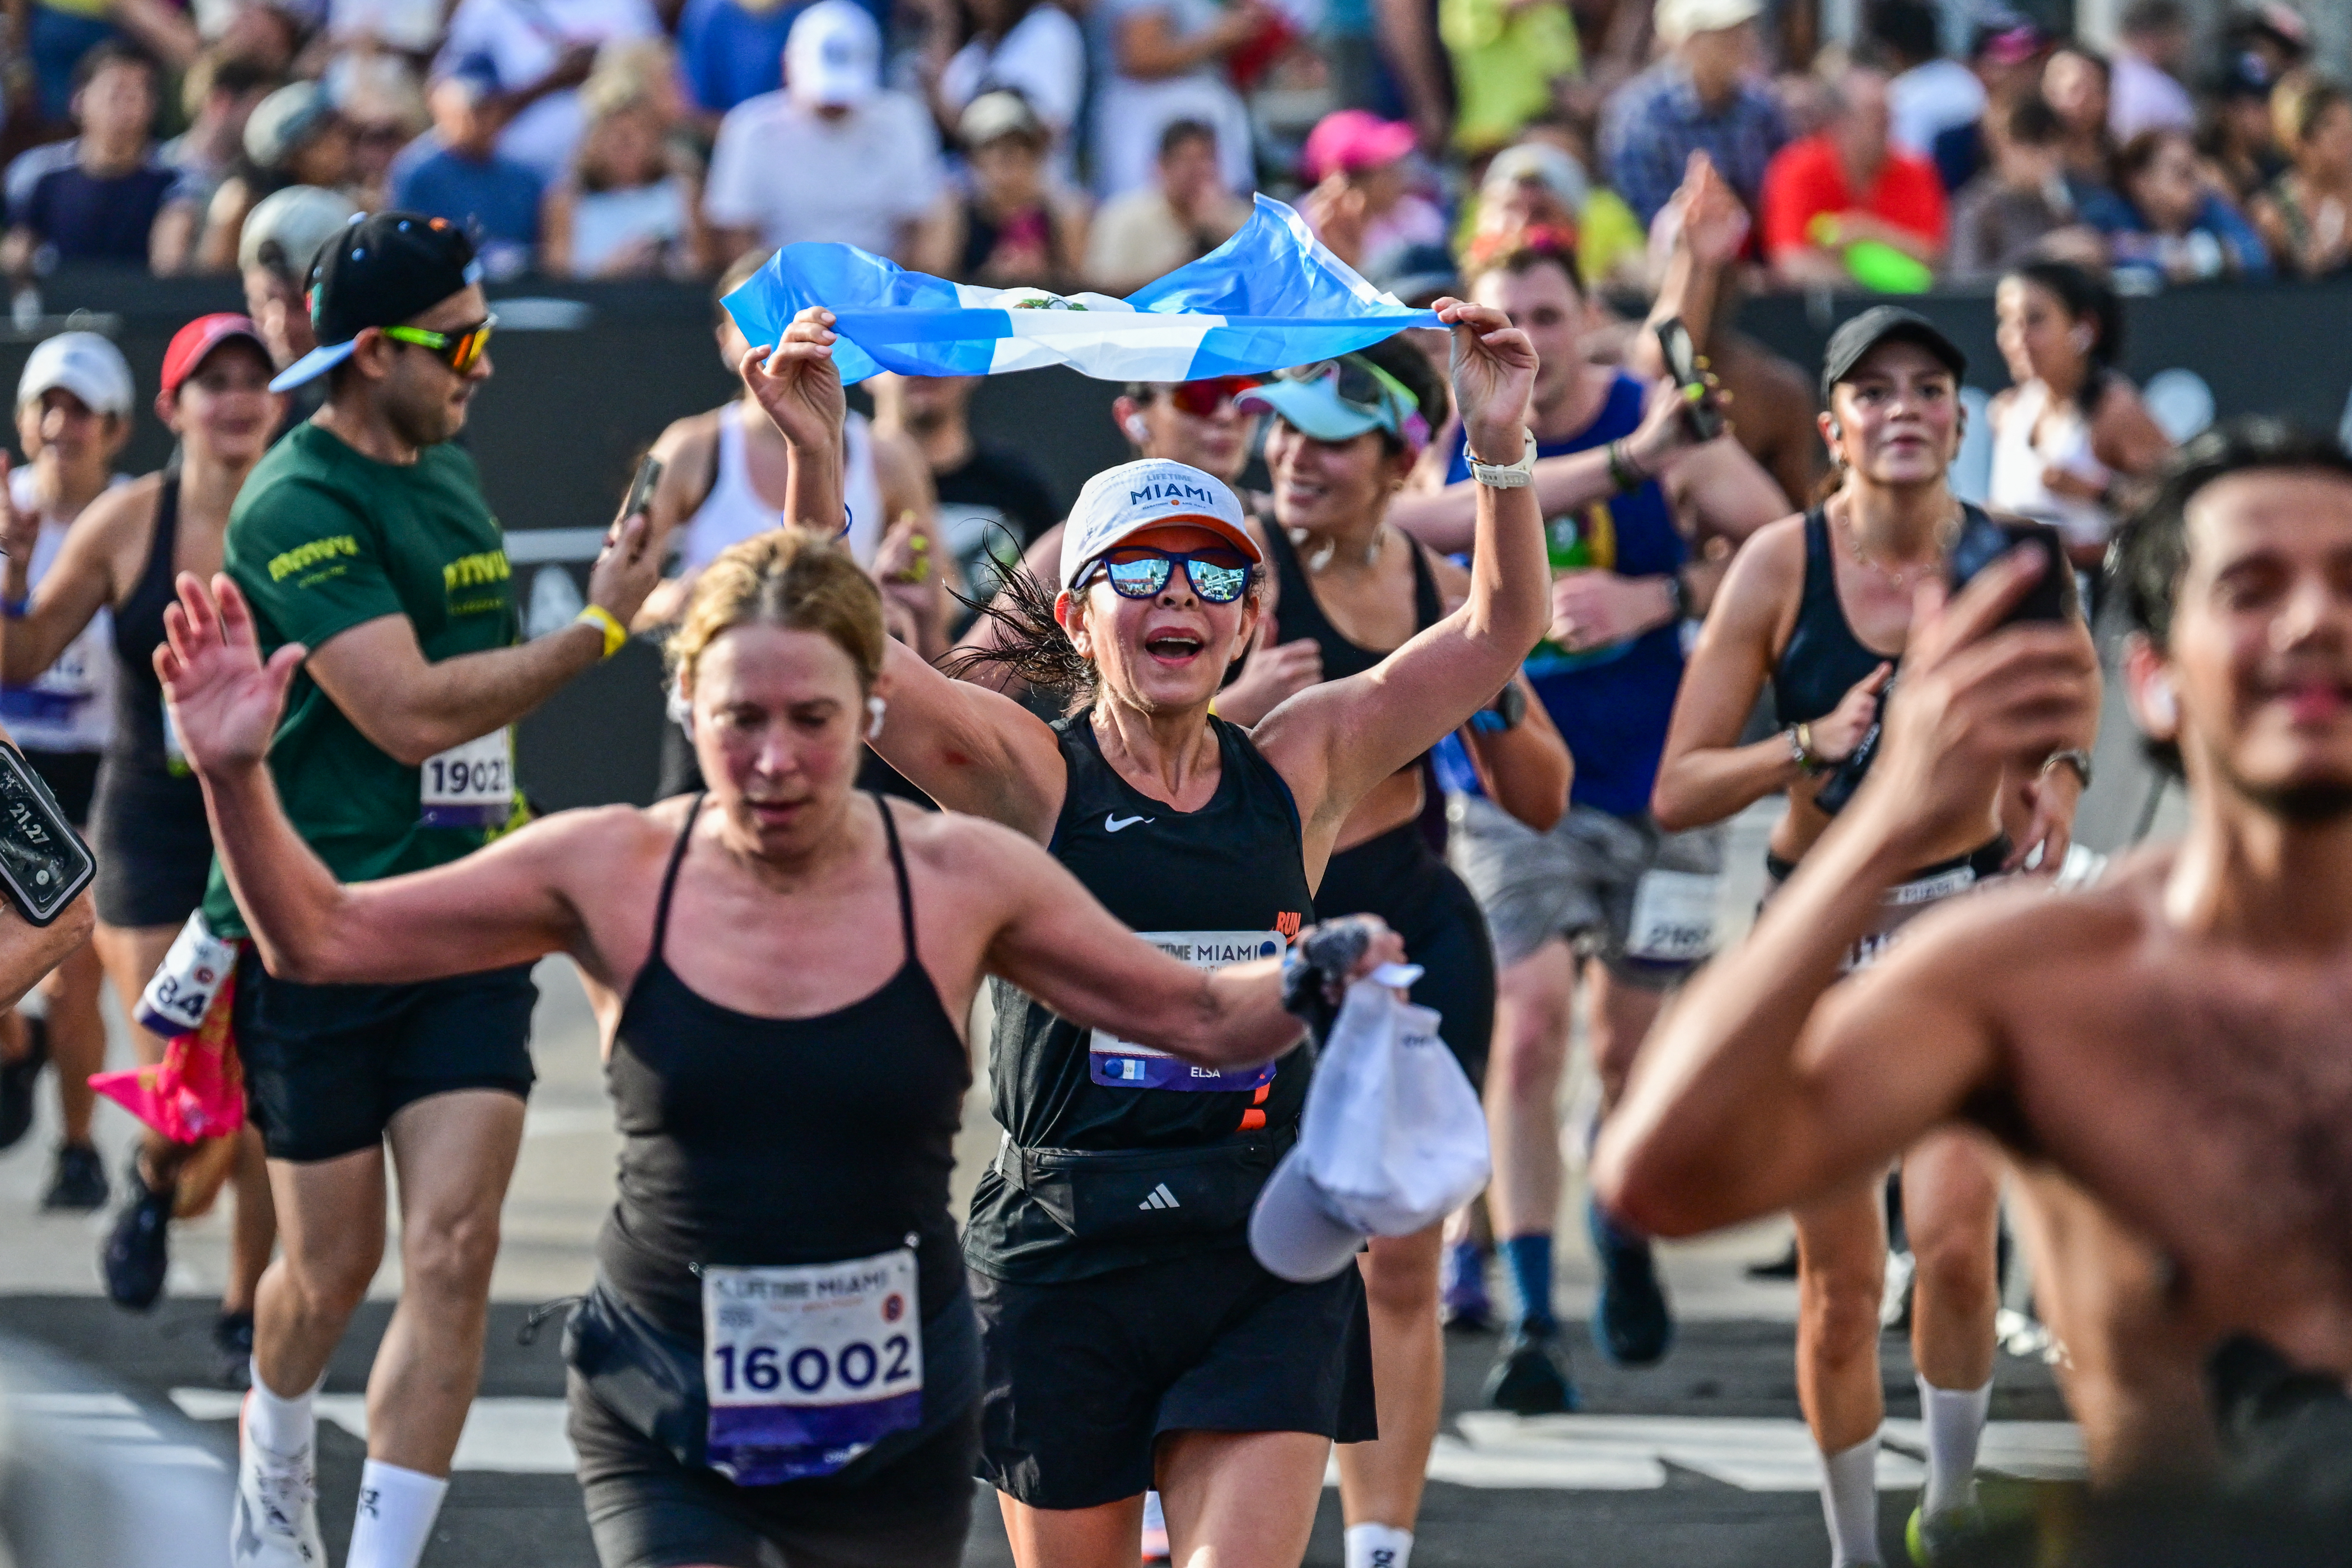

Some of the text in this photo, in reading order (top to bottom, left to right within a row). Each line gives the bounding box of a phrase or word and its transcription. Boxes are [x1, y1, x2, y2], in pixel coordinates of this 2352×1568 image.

[1130, 483, 1213, 505] MIAMI
[9, 802, 50, 844] 21.27
[1275, 911, 1301, 935] RUN
[1197, 945, 1258, 961] MIAMI
[1191, 1066, 1221, 1078] ELSA
[714, 1333, 911, 1394] 16002
